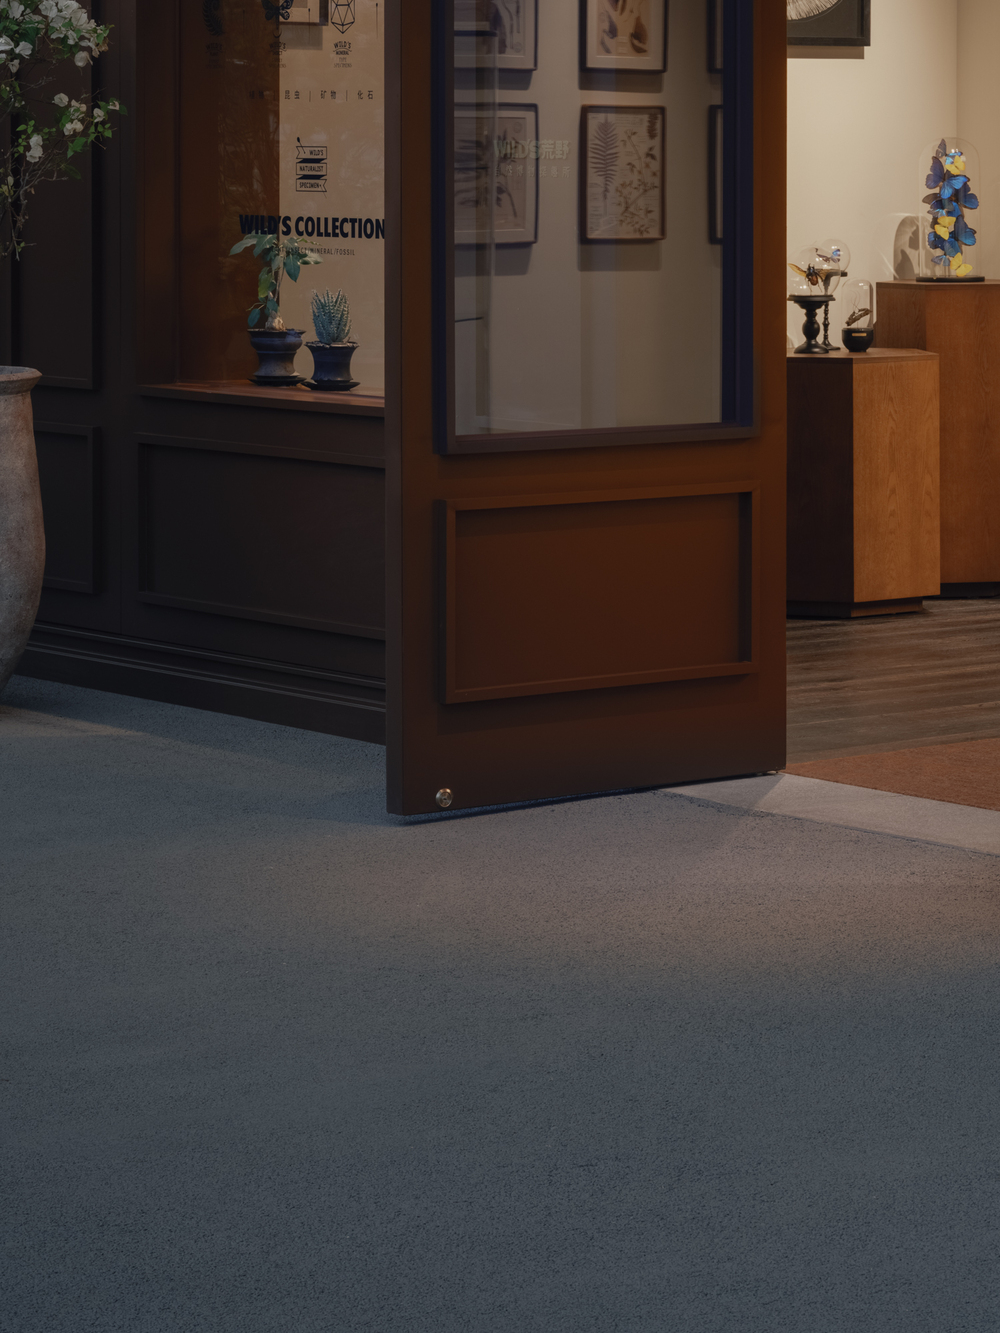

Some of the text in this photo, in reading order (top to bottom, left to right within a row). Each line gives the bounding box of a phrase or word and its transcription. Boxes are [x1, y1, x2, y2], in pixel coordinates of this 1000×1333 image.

[299, 165, 324, 173] NATURALIST
[299, 181, 320, 189] SPECIMEN
[239, 214, 385, 239] WILD'S COLLECTION
